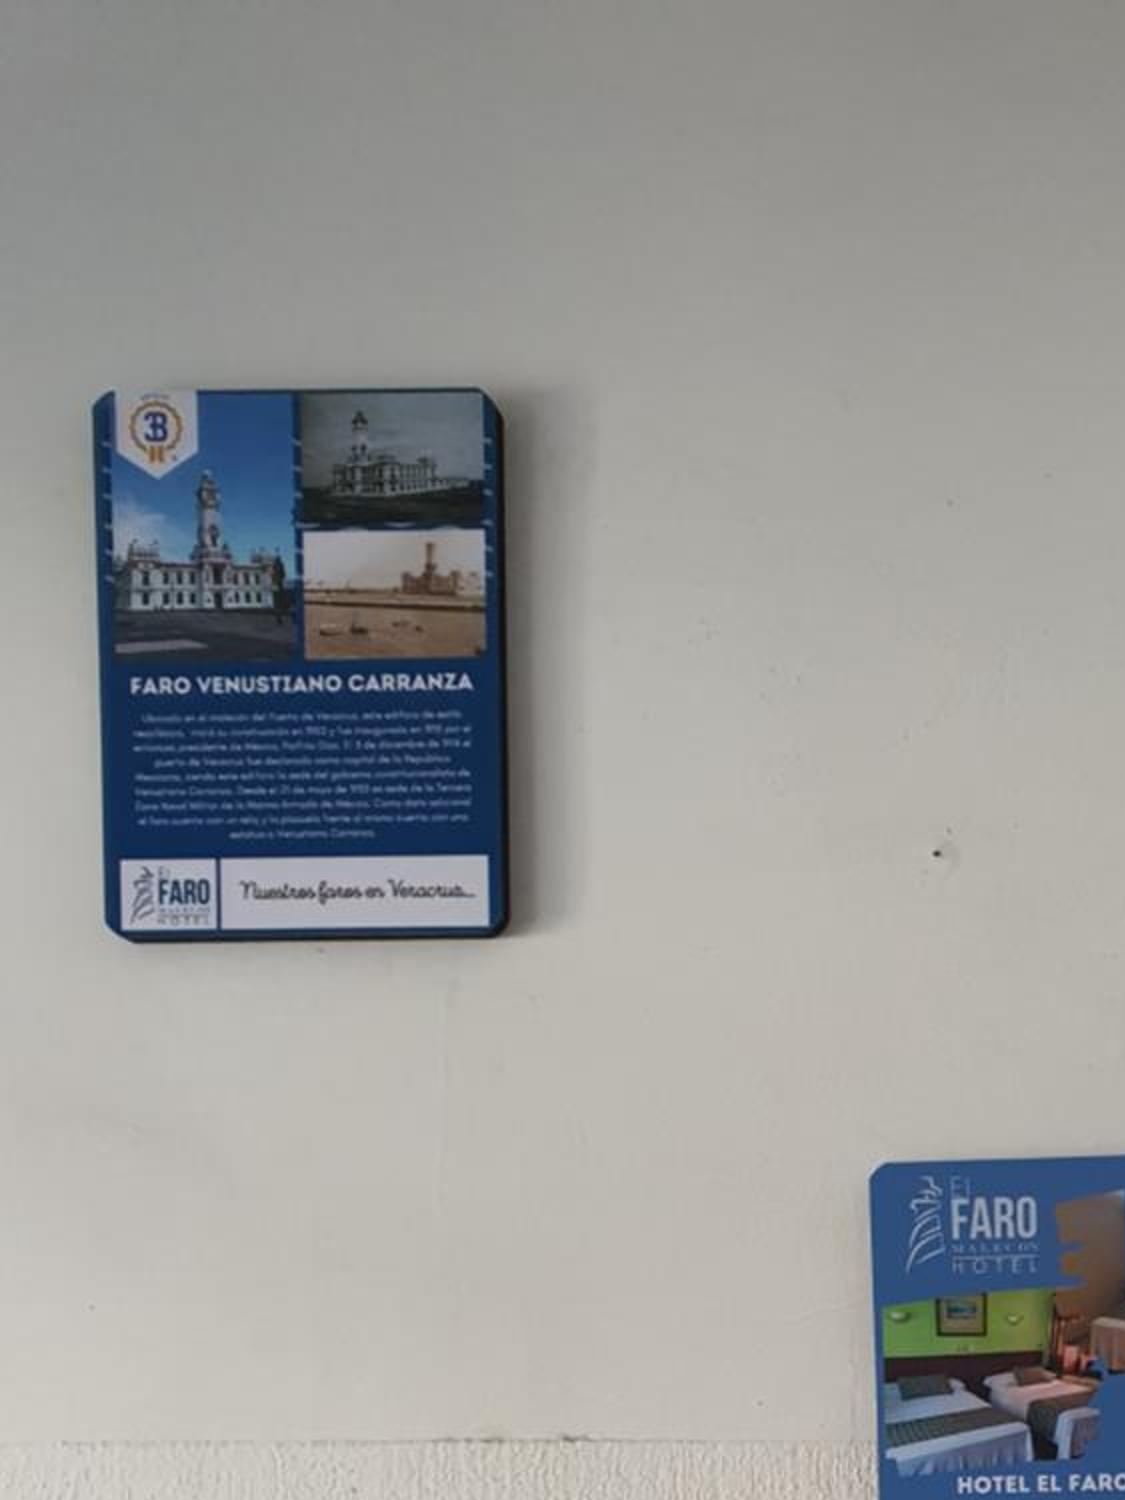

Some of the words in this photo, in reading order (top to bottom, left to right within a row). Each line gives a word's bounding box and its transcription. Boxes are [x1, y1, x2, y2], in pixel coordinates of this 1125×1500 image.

[130, 675, 192, 695] FARO
[196, 674, 342, 694] VENUSTIANO
[347, 672, 475, 693] CARRANZA
[159, 878, 211, 905] FARO
[239, 879, 316, 900] Nuestros
[317, 880, 363, 905] faros
[364, 885, 385, 899] en
[950, 1196, 1038, 1240] FARO
[957, 1475, 1029, 1494] HOTEL
[1037, 1474, 1062, 1493] EL
